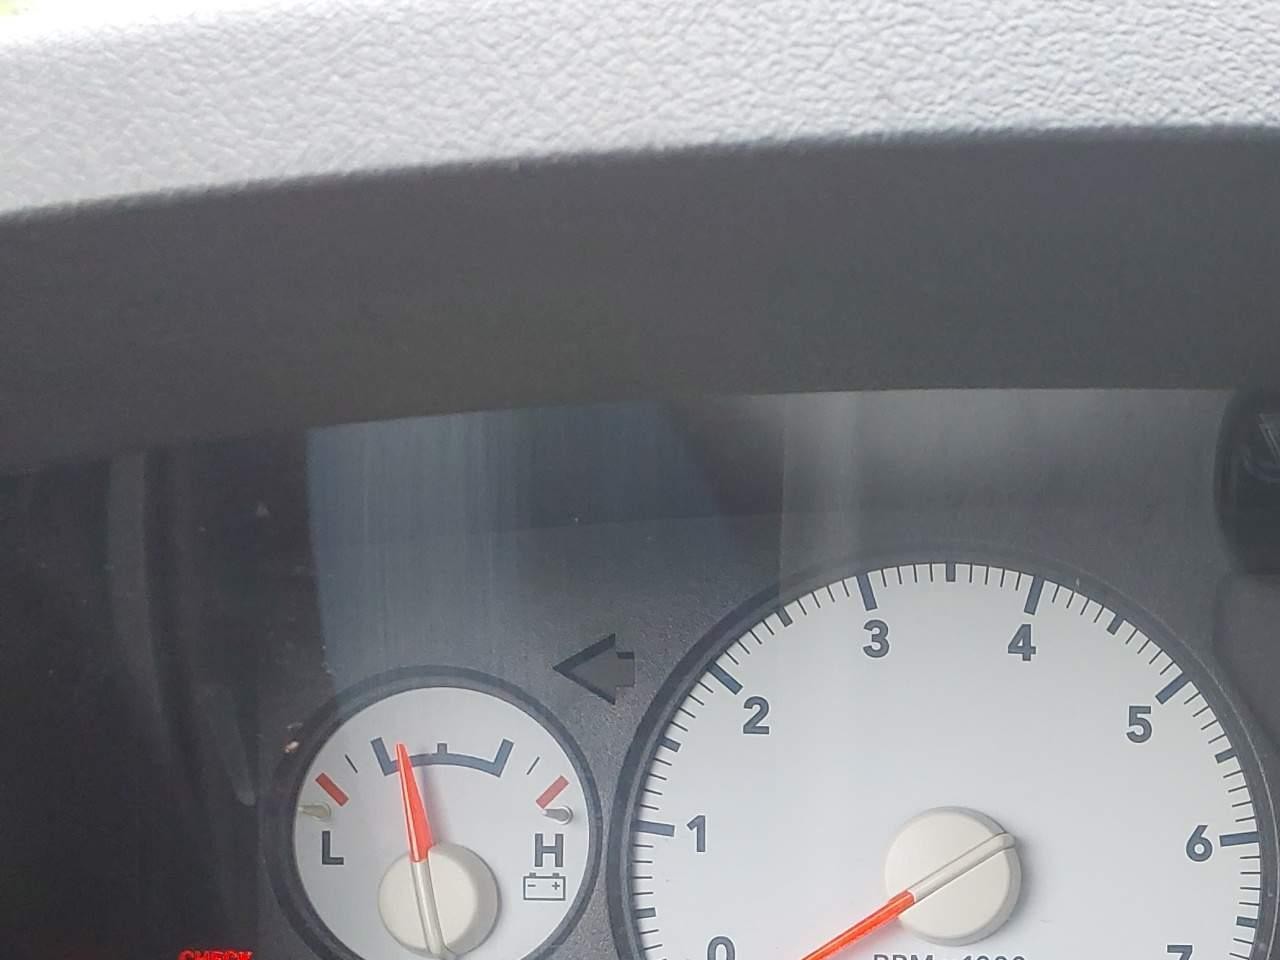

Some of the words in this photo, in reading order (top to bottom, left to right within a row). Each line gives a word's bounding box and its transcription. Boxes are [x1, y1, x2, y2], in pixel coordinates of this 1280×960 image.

[864, 620, 889, 658] 3
[1008, 624, 1036, 661] 4
[743, 696, 769, 734] 2
[1127, 706, 1152, 743] 5
[322, 831, 344, 865] L
[535, 834, 563, 867] H
[687, 815, 705, 852] 1
[1186, 825, 1212, 862] 6
